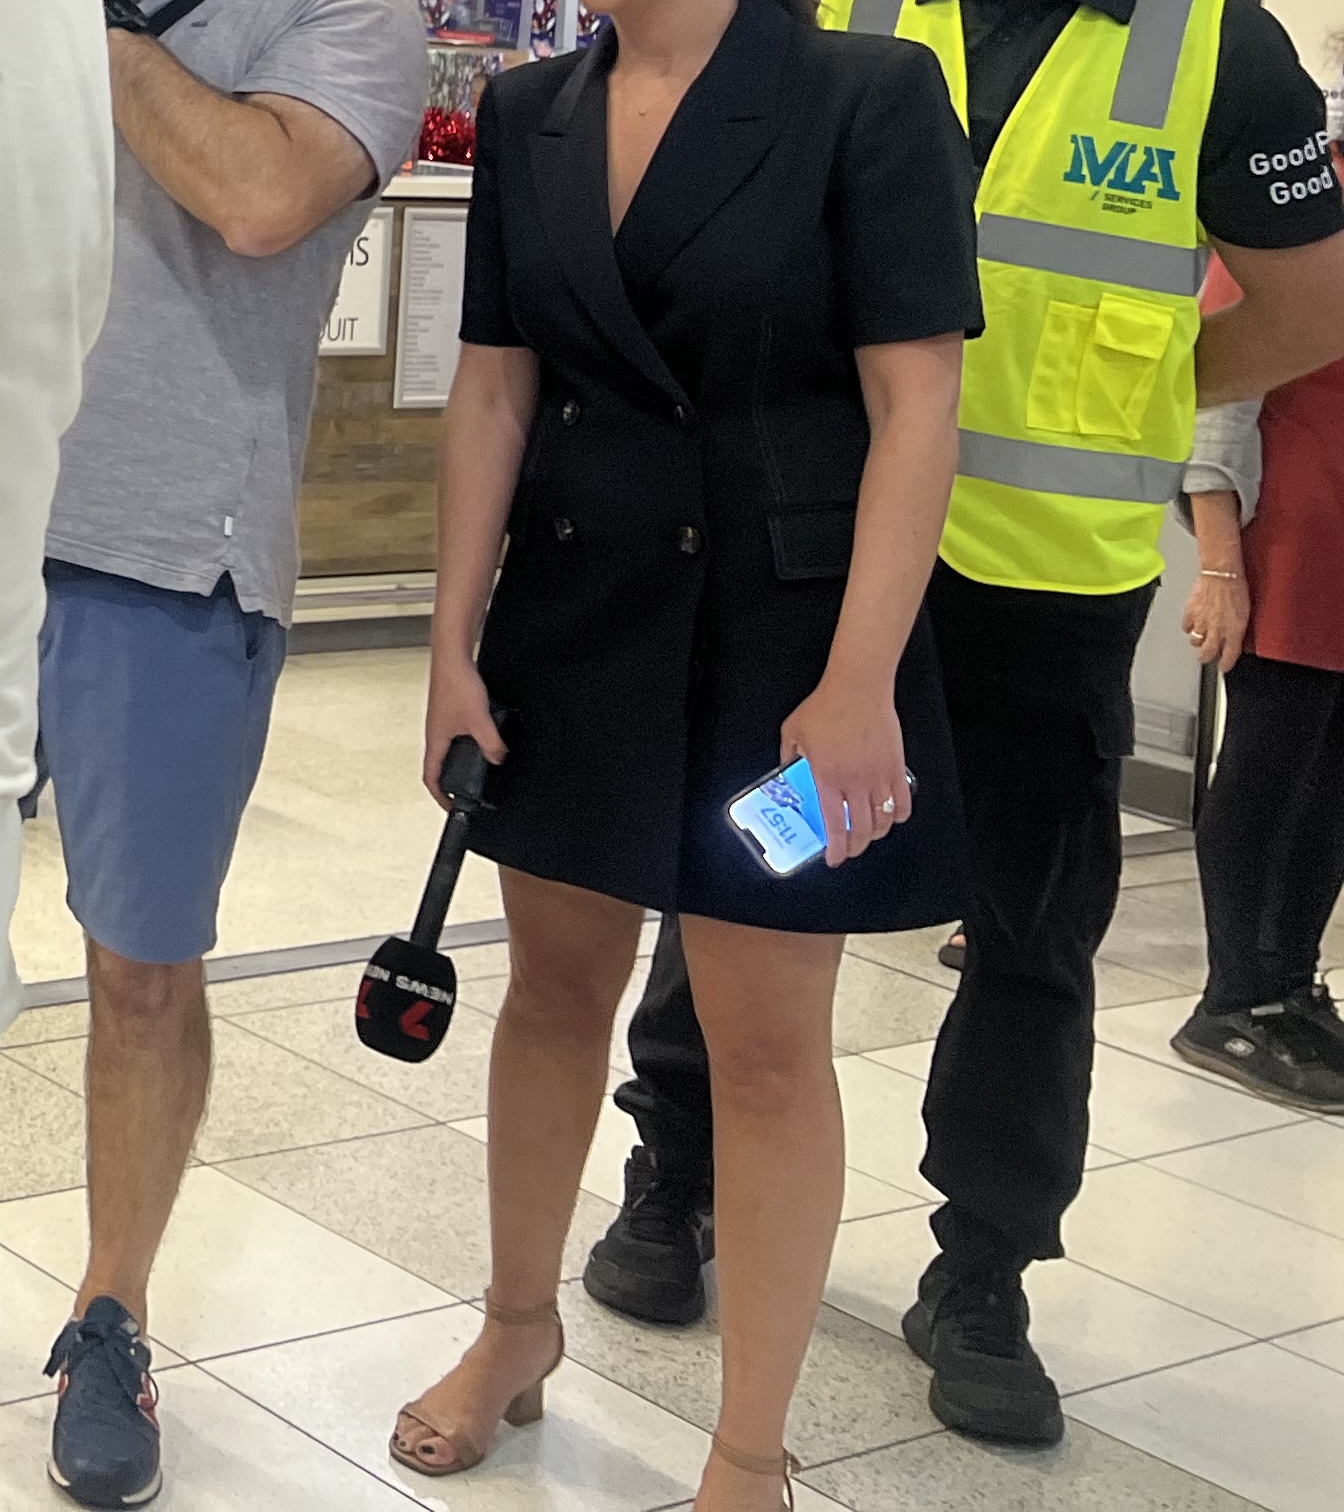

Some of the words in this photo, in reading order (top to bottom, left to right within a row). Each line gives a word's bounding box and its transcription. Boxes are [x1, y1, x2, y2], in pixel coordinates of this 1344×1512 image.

[1063, 134, 1181, 201] MA
[1104, 193, 1152, 209] SERVICES
[1269, 165, 1333, 205] Good
[1102, 203, 1137, 215] GROUP
[760, 807, 798, 845] 11:57
[396, 975, 454, 1005] NEWS
